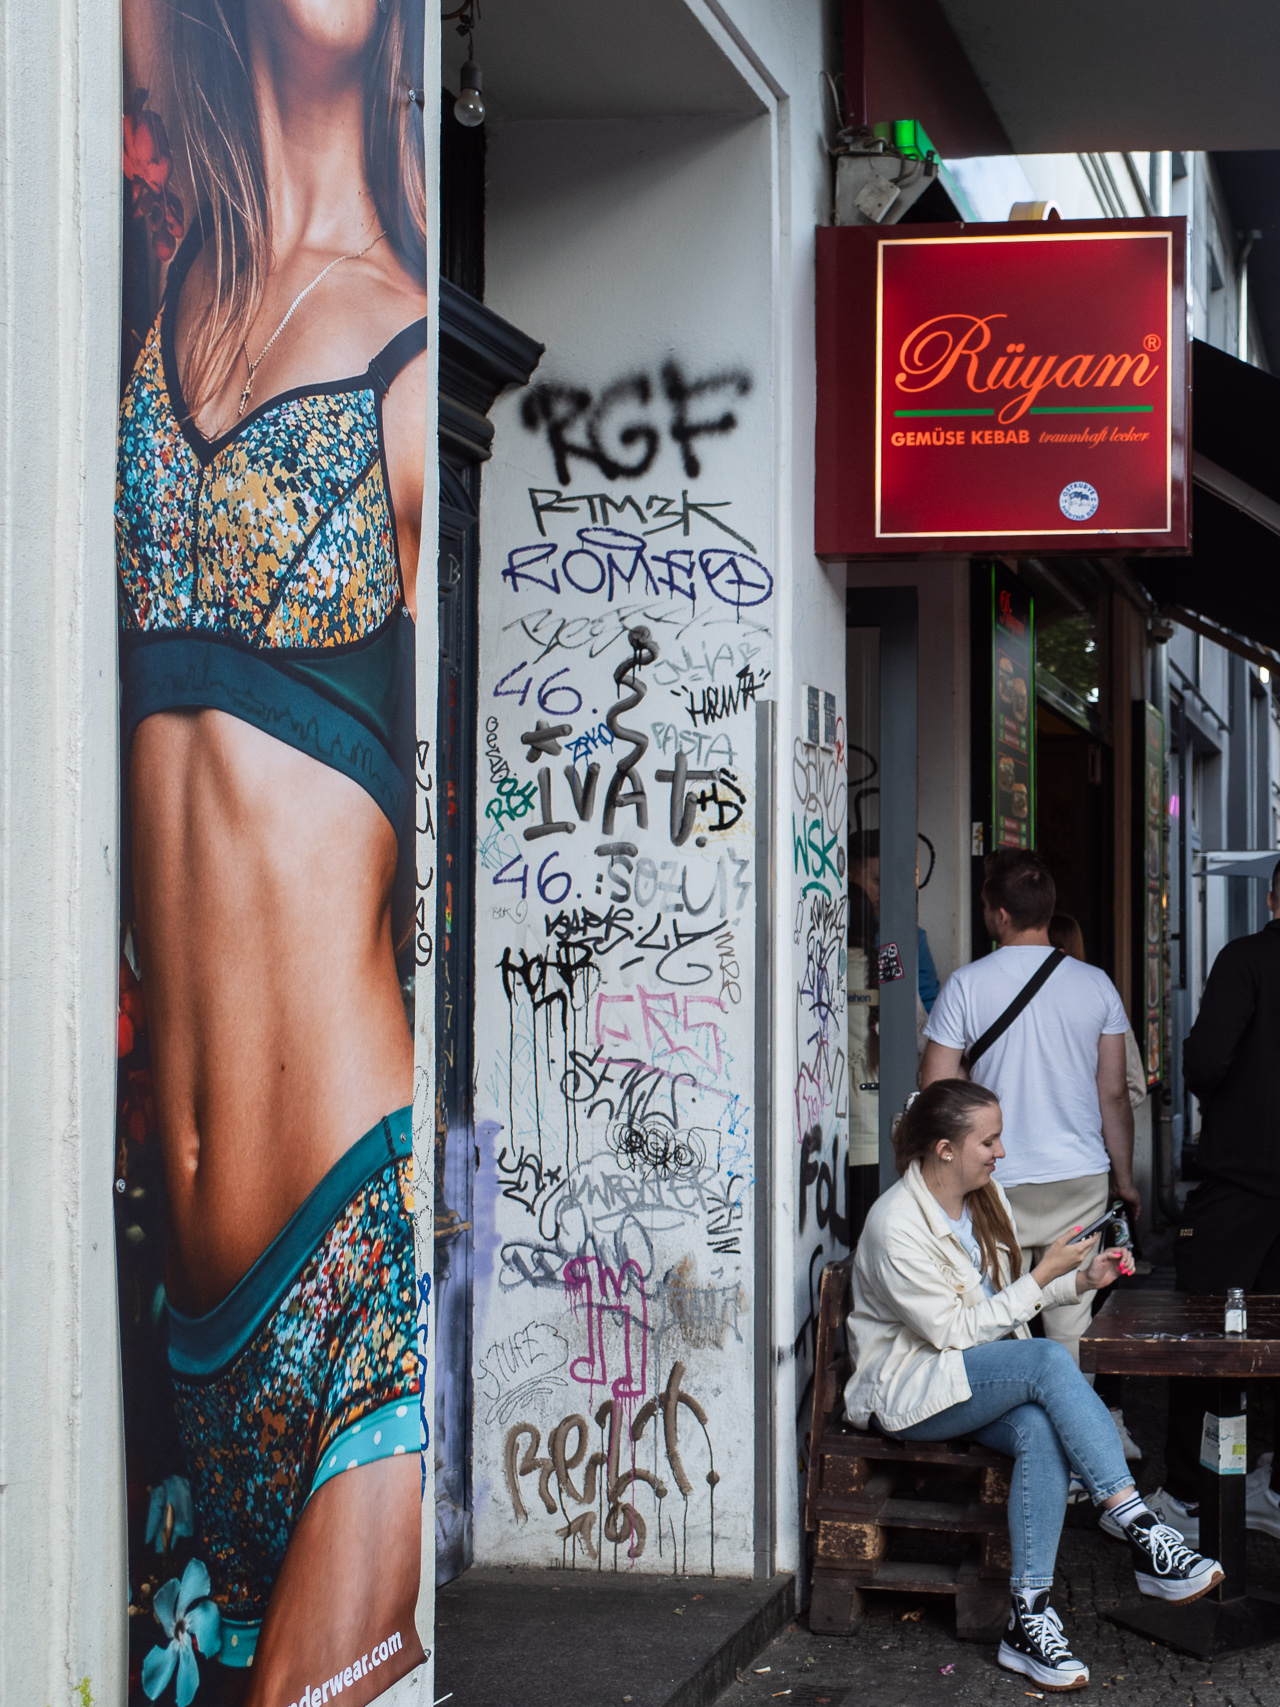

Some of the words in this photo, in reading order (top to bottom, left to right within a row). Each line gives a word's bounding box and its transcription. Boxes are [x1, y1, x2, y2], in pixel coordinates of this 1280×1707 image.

[891, 427, 965, 447] GEMÜSE
[971, 429, 1030, 445] KEBAB
[1039, 427, 1109, 449] traumhaft
[1109, 428, 1150, 443] lecker
[287, 1631, 403, 1707] derwear.com
